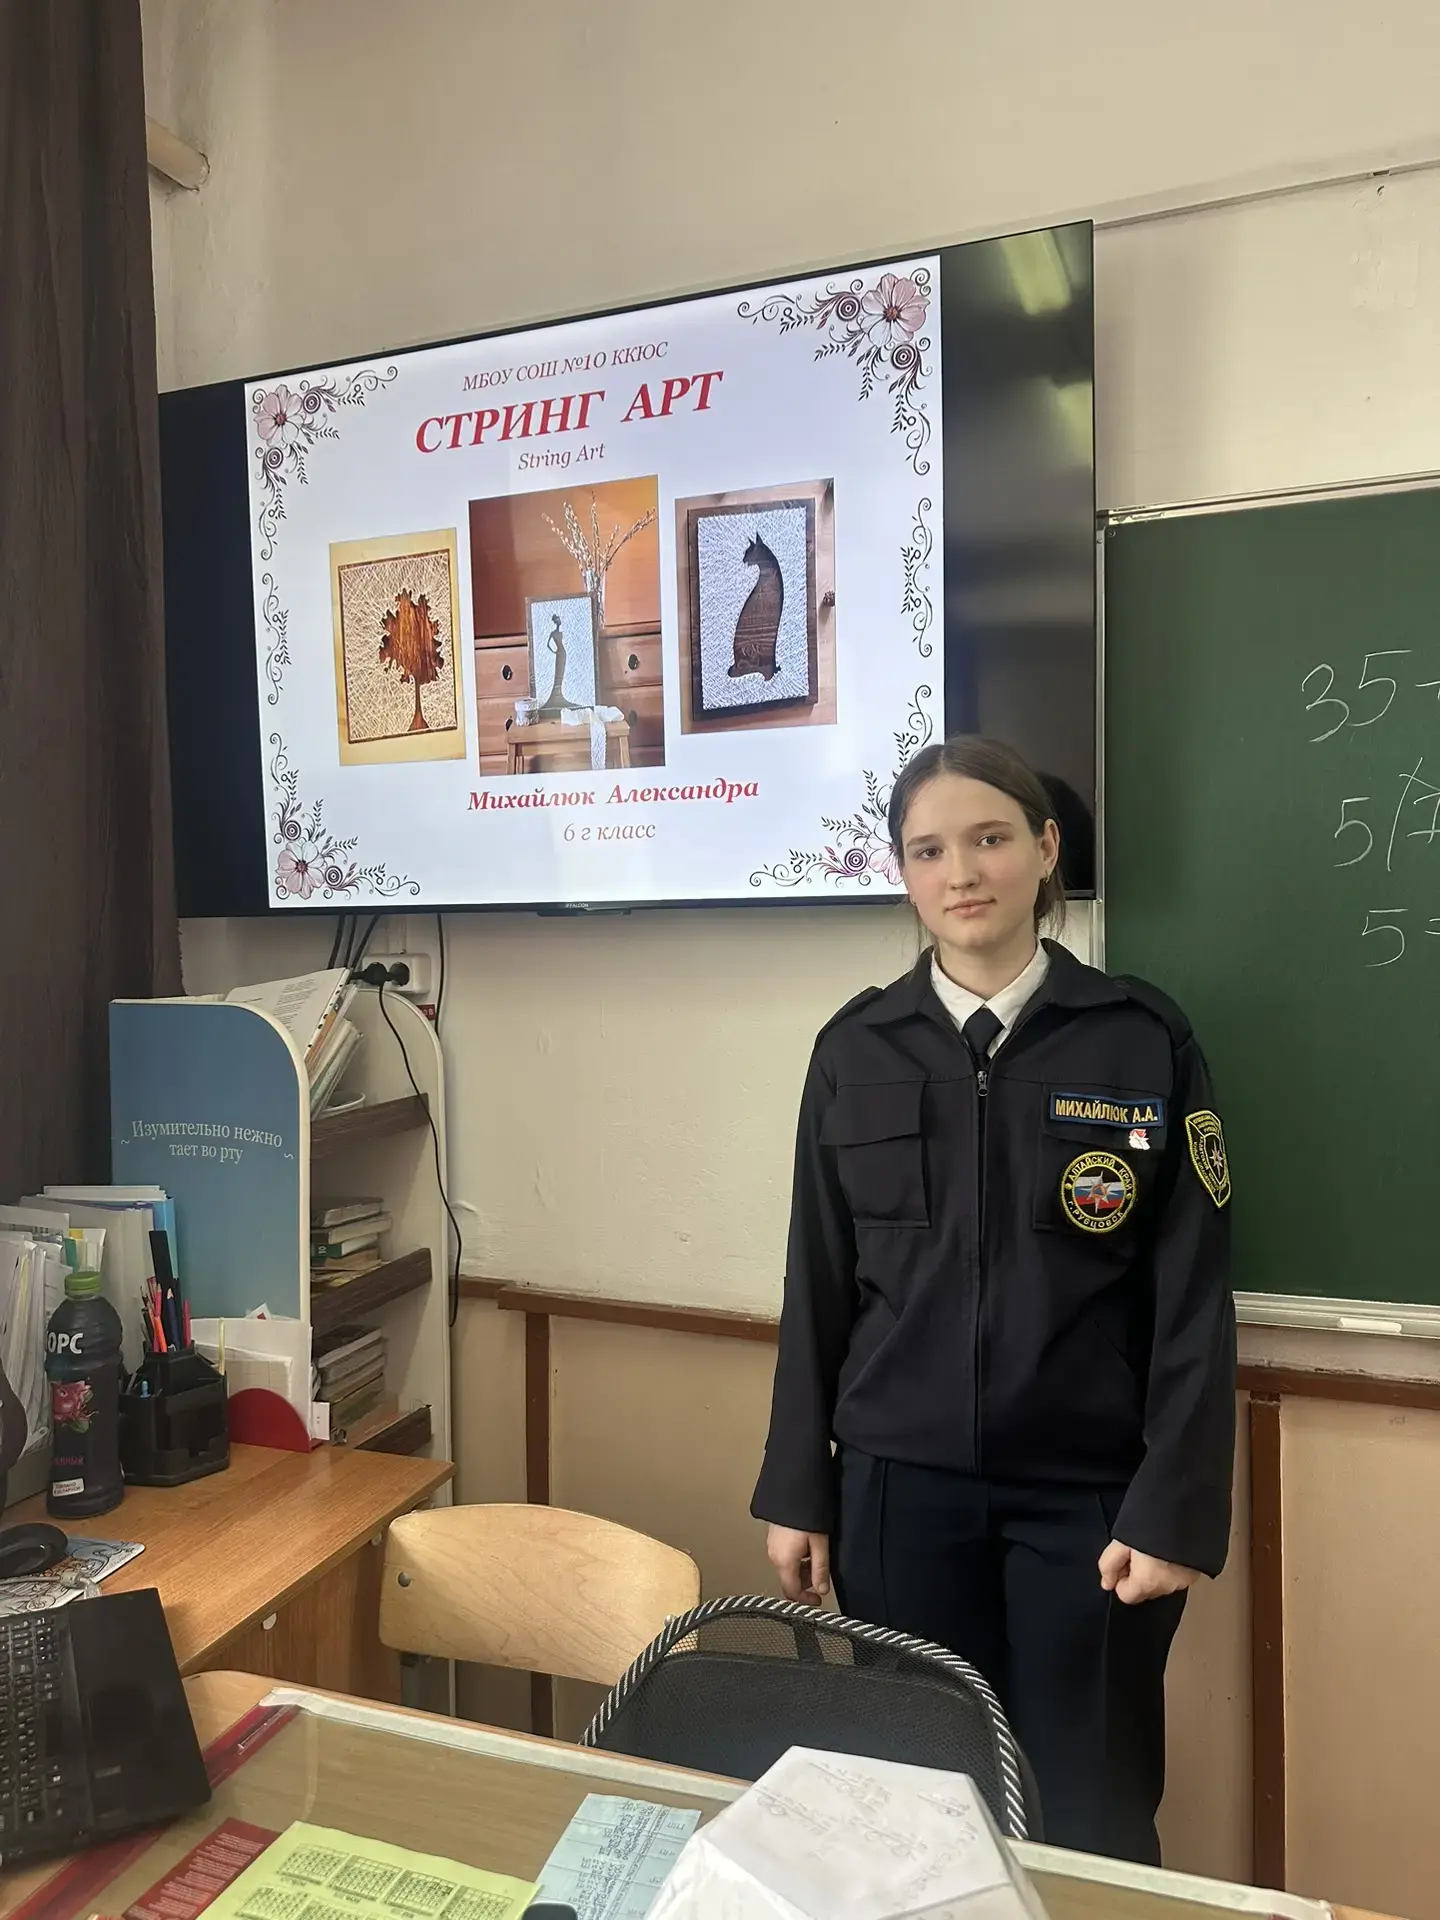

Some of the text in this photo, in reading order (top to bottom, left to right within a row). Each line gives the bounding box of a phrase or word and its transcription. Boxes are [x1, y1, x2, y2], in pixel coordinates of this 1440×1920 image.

[462, 341, 668, 393] МБОУ СОШ №10 ККЮС
[415, 370, 724, 454] СТРИНГ АРТ
[517, 442, 606, 471] String Art
[467, 777, 760, 812] Михайлюк Александра
[563, 822, 656, 842] 6 г класс
[1055, 1099, 1158, 1123] МИХАЙЛЮК А.А.
[132, 1120, 283, 1148] Изумительно нежно
[169, 1142, 244, 1165] тает во рту
[1068, 1155, 1133, 1190] АЛТАЙСКИЙ КРАЙ
[47, 1331, 84, 1354] ОРС
